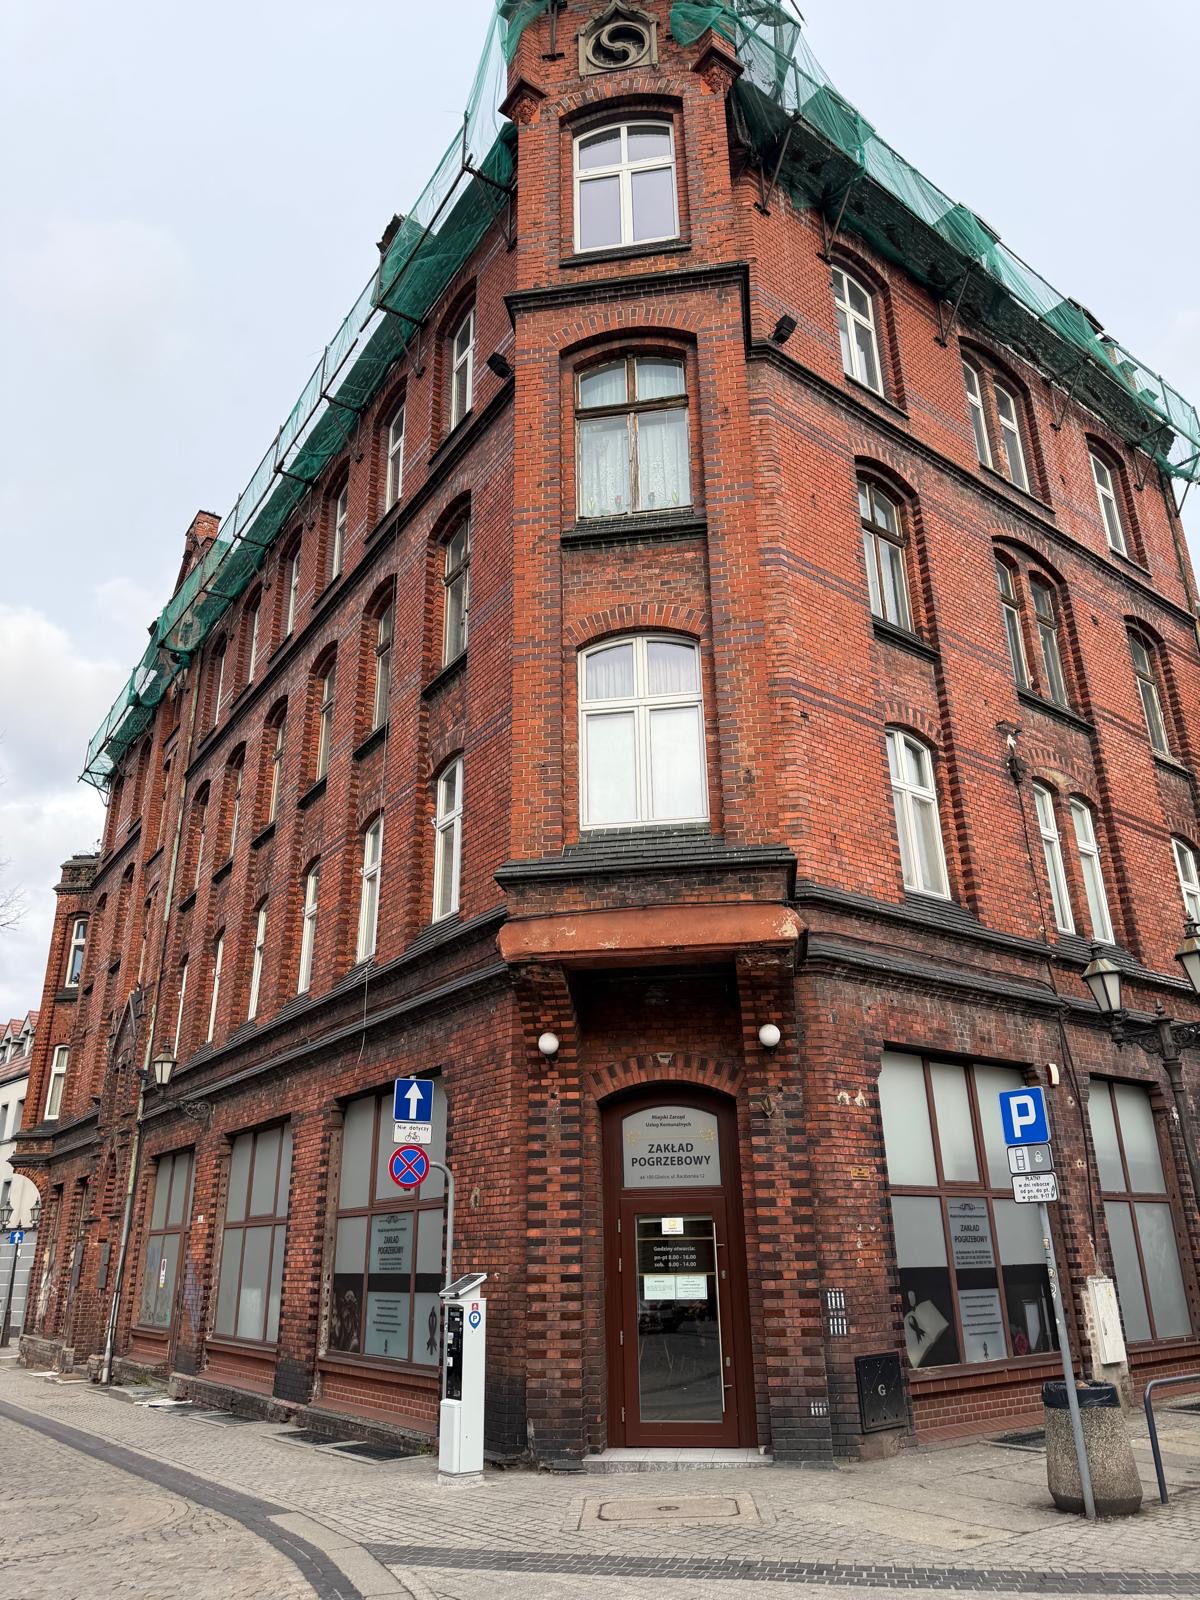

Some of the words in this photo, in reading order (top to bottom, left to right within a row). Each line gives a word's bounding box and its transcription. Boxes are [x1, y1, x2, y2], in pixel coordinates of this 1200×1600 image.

[1009, 1095, 1036, 1138] P
[648, 1143, 694, 1153] ZAKŁAD
[631, 1155, 711, 1167] POGRZEBOWY
[954, 1235, 988, 1243] POGRZEBOWY
[878, 1384, 887, 1396] G
